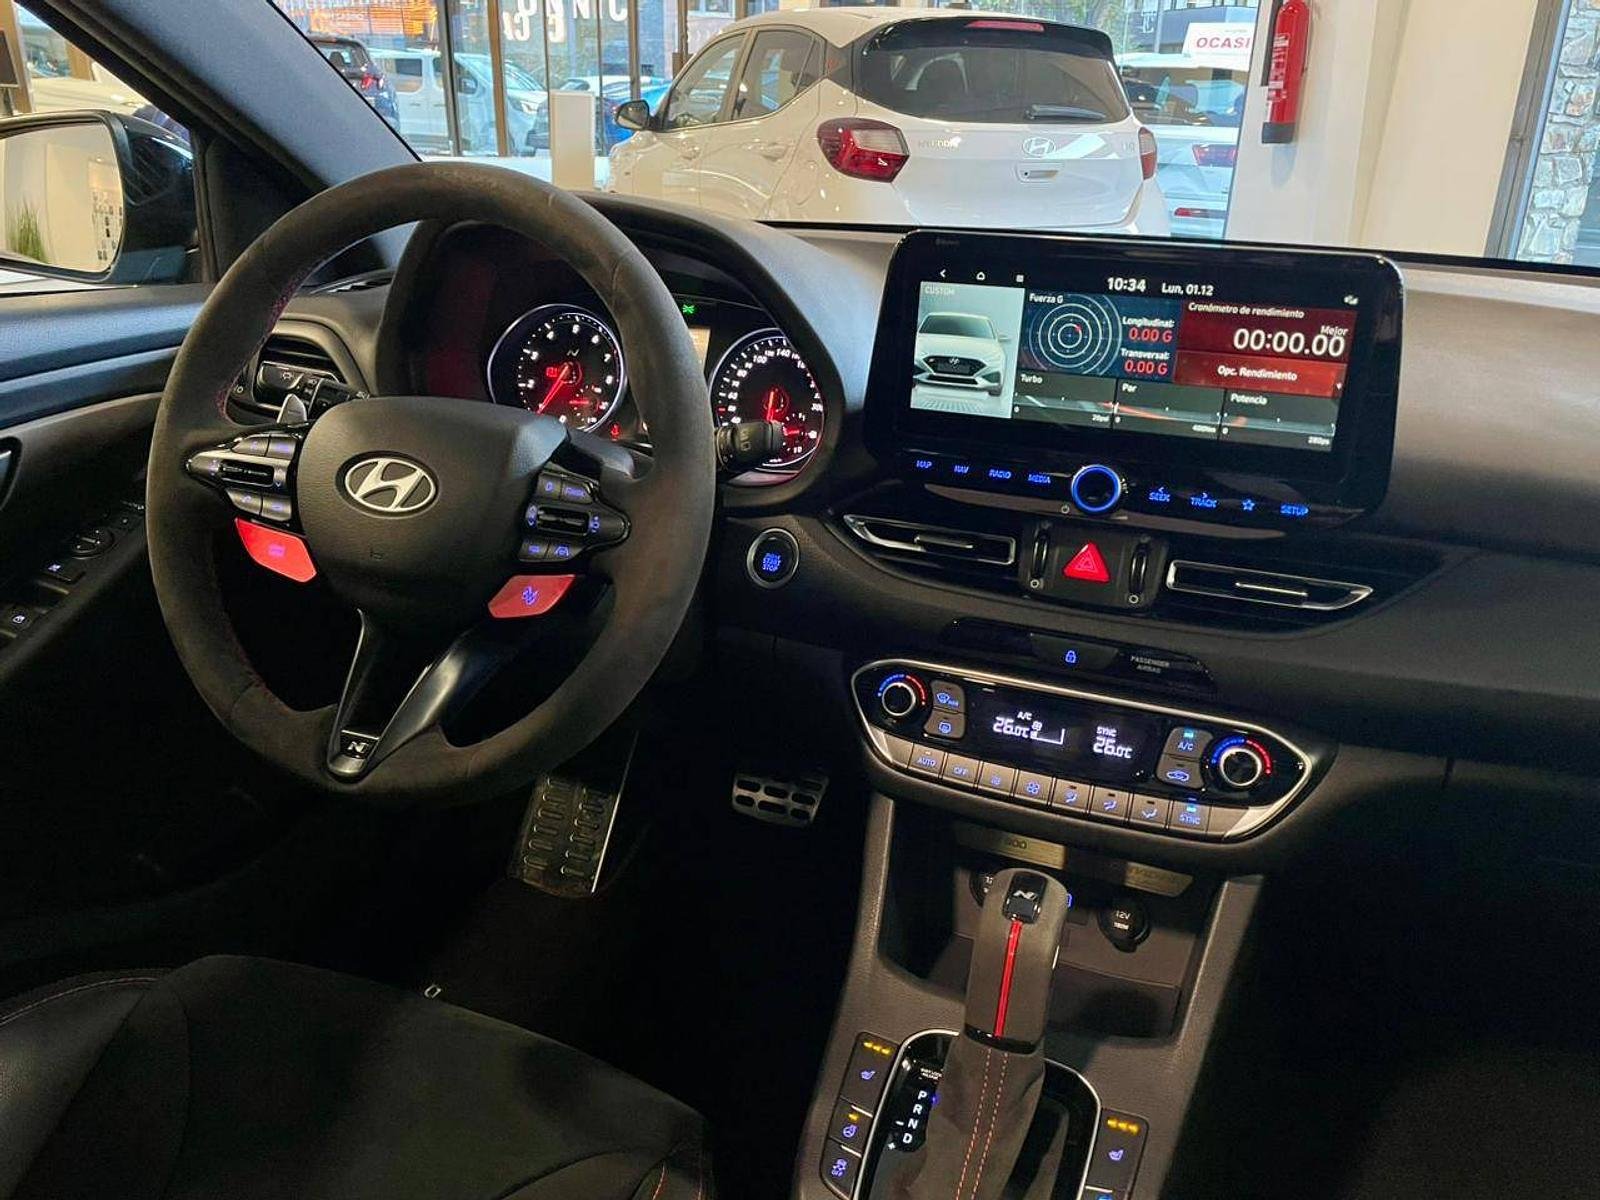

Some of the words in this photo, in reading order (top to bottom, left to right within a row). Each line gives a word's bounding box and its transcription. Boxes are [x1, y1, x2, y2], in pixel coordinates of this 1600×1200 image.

[1196, 36, 1251, 49] OCASI
[924, 286, 956, 296] CUSTOM
[1107, 277, 1146, 292] 10:34
[1161, 283, 1184, 295] Lun.
[1186, 284, 1214, 296] 01.12
[1029, 292, 1055, 303] Fuerza
[1188, 302, 1238, 315] Cronómetro
[1239, 305, 1250, 315] de
[1251, 307, 1305, 319] rendimiento
[1129, 327, 1159, 342] 0.00
[1162, 330, 1173, 343] G
[1320, 325, 1349, 337] Mejor
[1233, 328, 1345, 357] 00:00.00
[1124, 359, 1154, 374] 0.00
[1158, 362, 1168, 375] G
[1217, 364, 1237, 377] Opc.
[1239, 367, 1298, 381] Rendimiento
[1020, 373, 1043, 384] Turbo
[1122, 383, 1138, 393] Par
[1230, 393, 1268, 405] Potencia
[988, 468, 1013, 480] RADIO
[1027, 473, 1052, 485] MEDIA
[1190, 496, 1218, 509] TRACK
[1279, 504, 1310, 517] SETUP
[1017, 711, 1033, 721] A/C
[1178, 741, 1194, 752] A/C
[917, 757, 937, 768] AUTO
[1115, 909, 1131, 921] 12V
[917, 1090, 928, 1100] P
[913, 1103, 923, 1115] R
[907, 1118, 919, 1129] N
[902, 1132, 913, 1144] D
